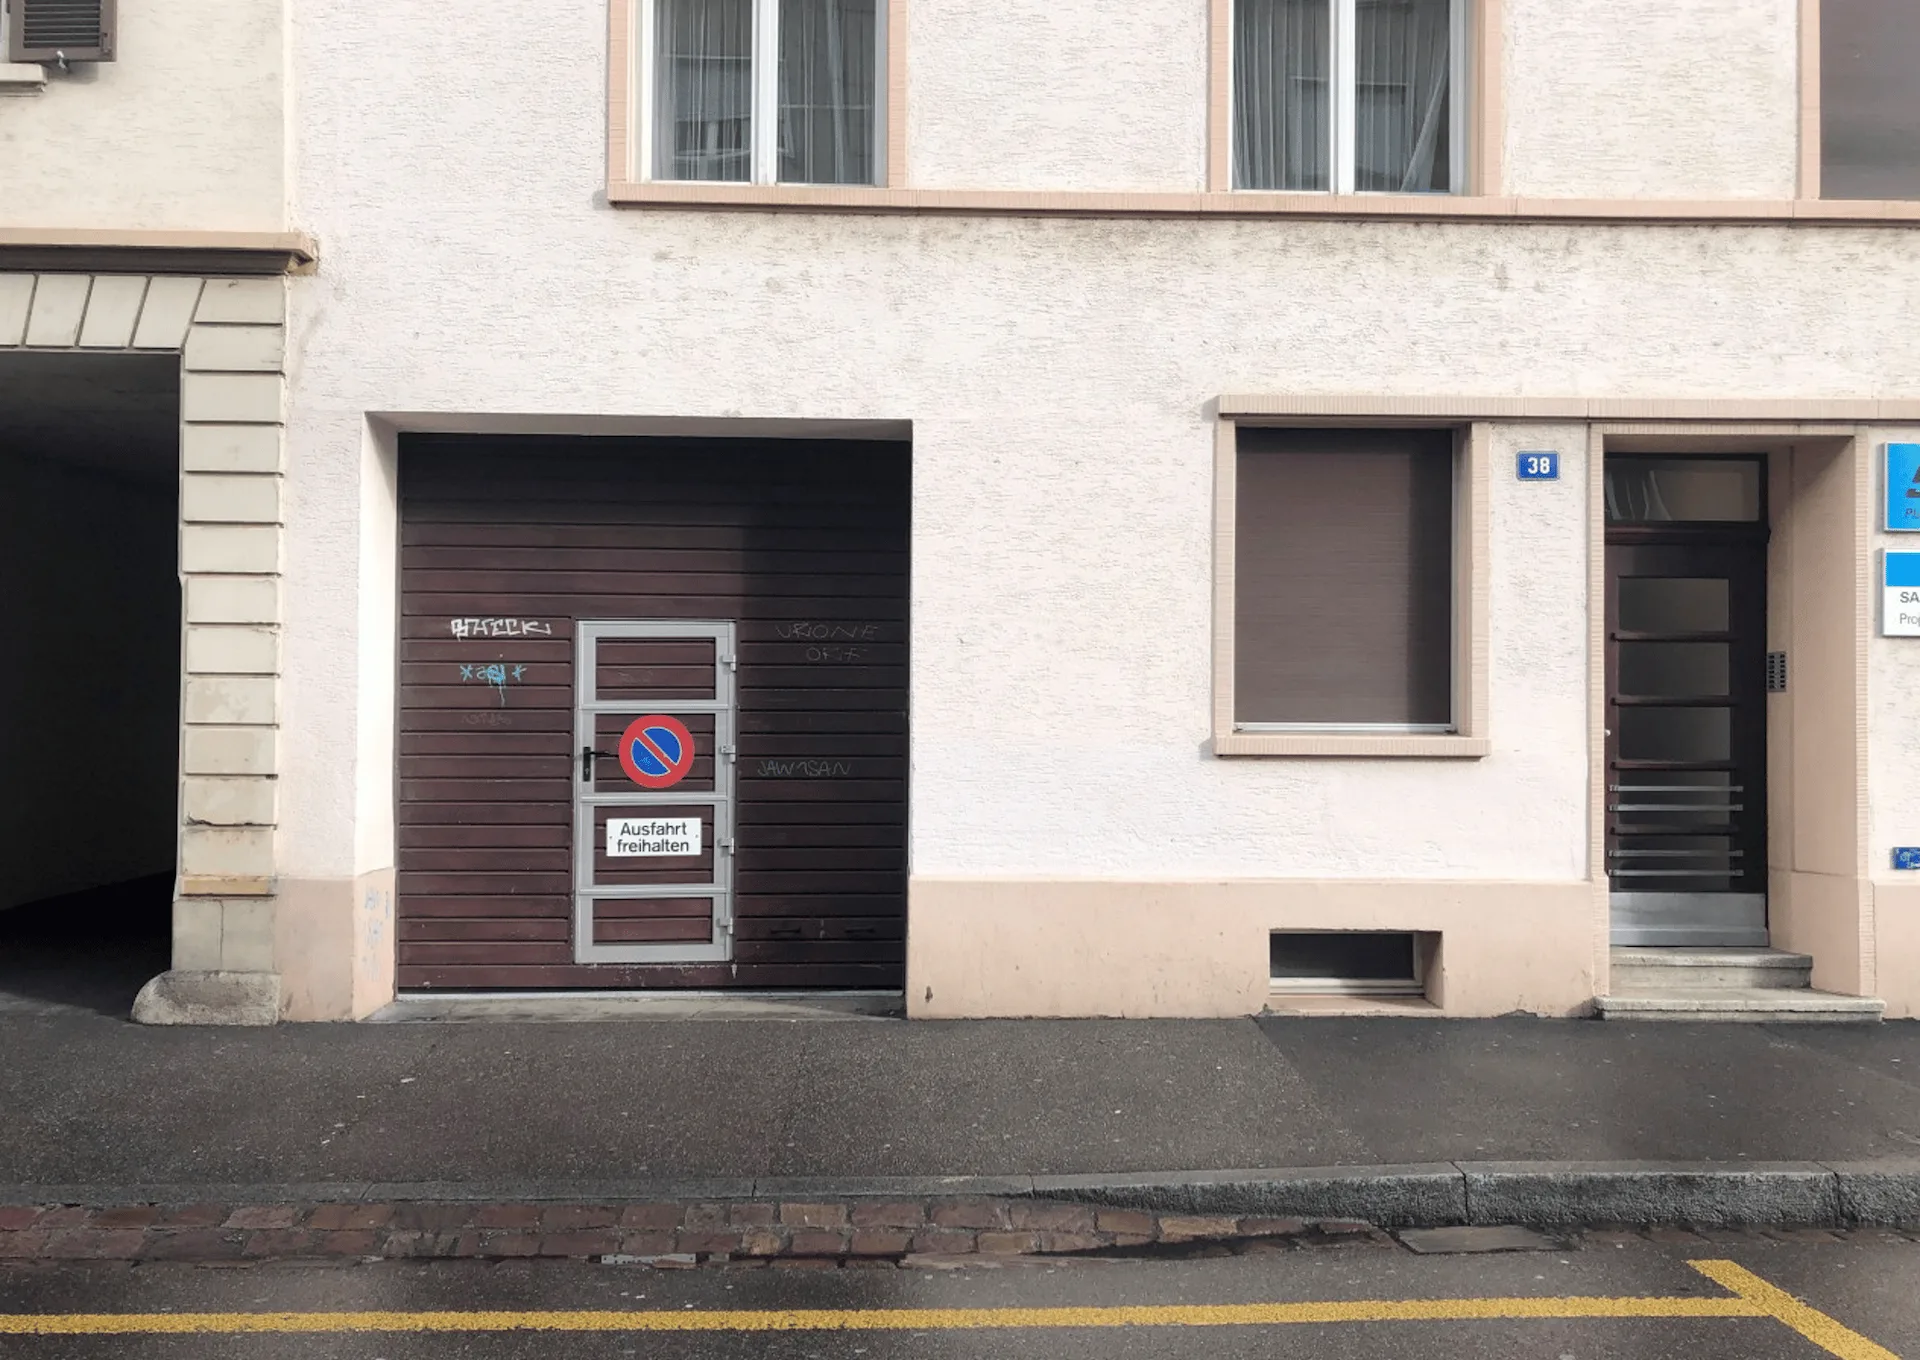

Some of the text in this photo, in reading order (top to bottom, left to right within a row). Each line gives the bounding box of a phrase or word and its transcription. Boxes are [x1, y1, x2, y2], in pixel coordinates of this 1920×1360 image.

[1527, 456, 1551, 475] 38
[620, 821, 688, 836] Ausfahrt
[617, 838, 690, 853] freihalten
